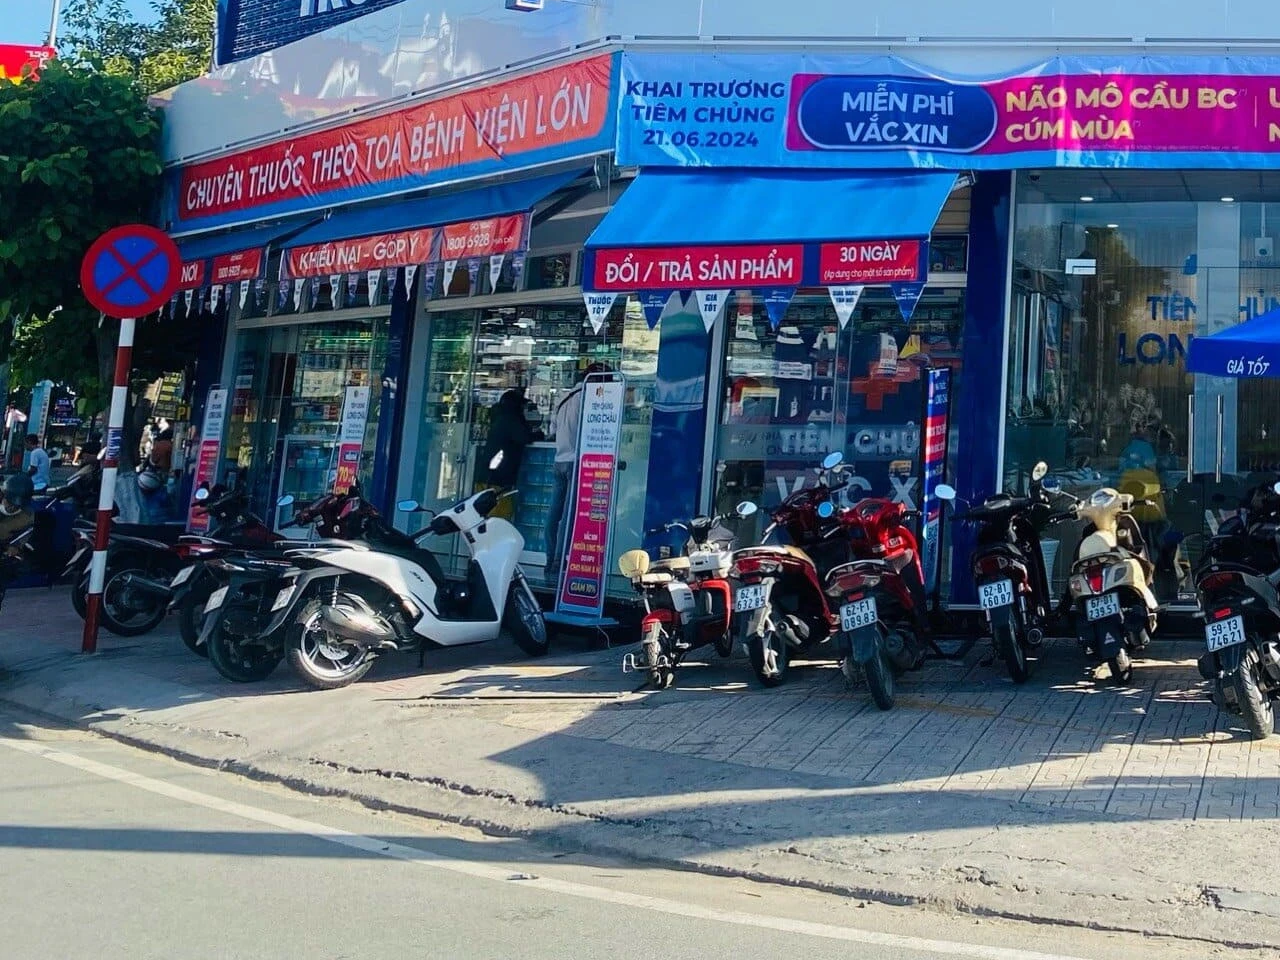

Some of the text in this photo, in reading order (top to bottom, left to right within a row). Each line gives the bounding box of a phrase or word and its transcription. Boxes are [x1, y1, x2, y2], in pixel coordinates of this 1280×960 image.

[626, 78, 785, 99] KHAI TRƯƠNG
[842, 82, 955, 116] MIỄN PHÍ
[1005, 85, 1067, 113] NÃO
[1075, 81, 1126, 109] MÔ
[1129, 81, 1190, 109] CẦU
[630, 100, 775, 123] TIÊM CHỦNG
[642, 129, 759, 148] 21.06.2024
[845, 113, 949, 145] VẮC XIN
[1005, 117, 1064, 143] CÚM
[187, 164, 244, 211] CHUYÊN
[249, 142, 305, 195] THUỐC
[365, 128, 402, 172] TOA
[410, 112, 465, 175] BỆNH
[475, 96, 528, 155] VIỆN
[536, 77, 593, 135] LỚN
[299, 246, 335, 271] KHIẾU
[839, 241, 901, 262] 30 NGÀY
[605, 252, 640, 284] ĐỔI
[659, 254, 694, 282] TRẢ
[698, 252, 737, 281] SẢN
[741, 249, 794, 280] PHẨM
[1226, 354, 1270, 376] GIÁ TỐT
[844, 610, 875, 629] 089.83
[846, 600, 870, 617] 62-F1
